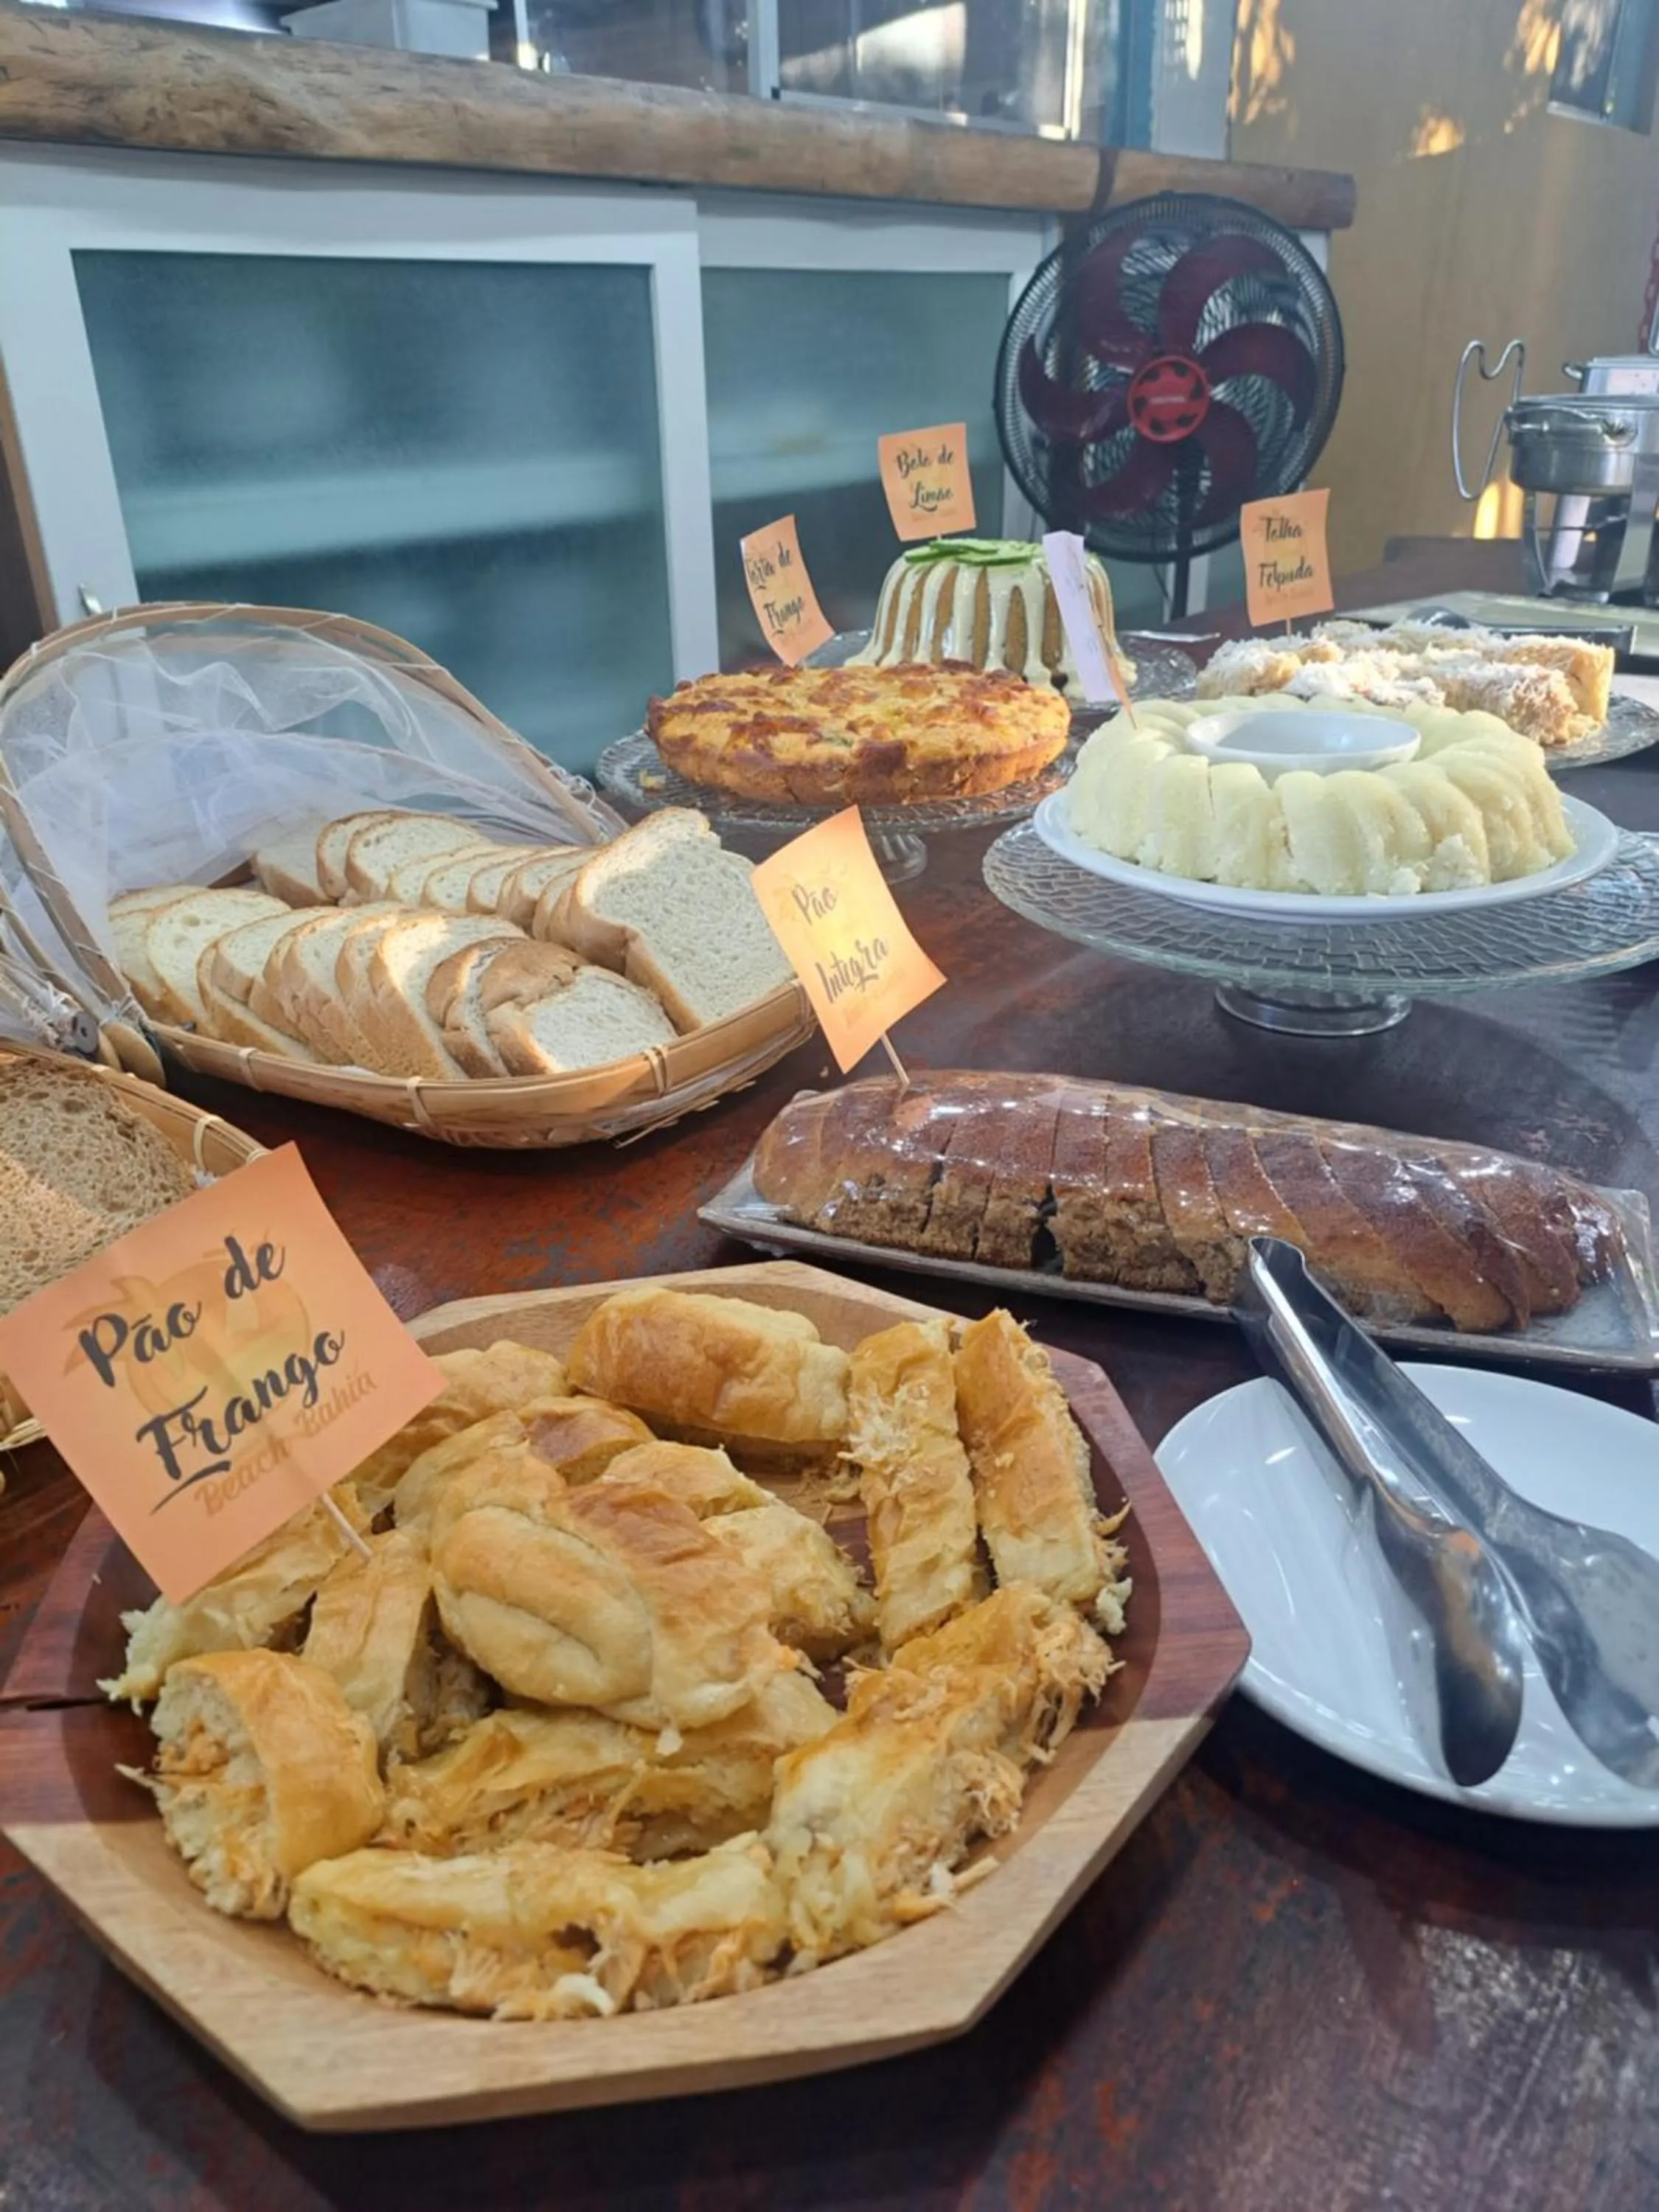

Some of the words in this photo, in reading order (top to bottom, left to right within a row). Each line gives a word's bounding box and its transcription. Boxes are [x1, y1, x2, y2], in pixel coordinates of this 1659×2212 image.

[937, 443, 954, 465] de
[1259, 516, 1302, 543] Telha
[790, 883, 838, 927] Pão
[815, 938, 888, 1004] Integra
[77, 1301, 202, 1388] Pão
[223, 1234, 286, 1301] de
[136, 1329, 346, 1514] Frango
[193, 1432, 291, 1518] Beach
[293, 1363, 378, 1439] Bahia
